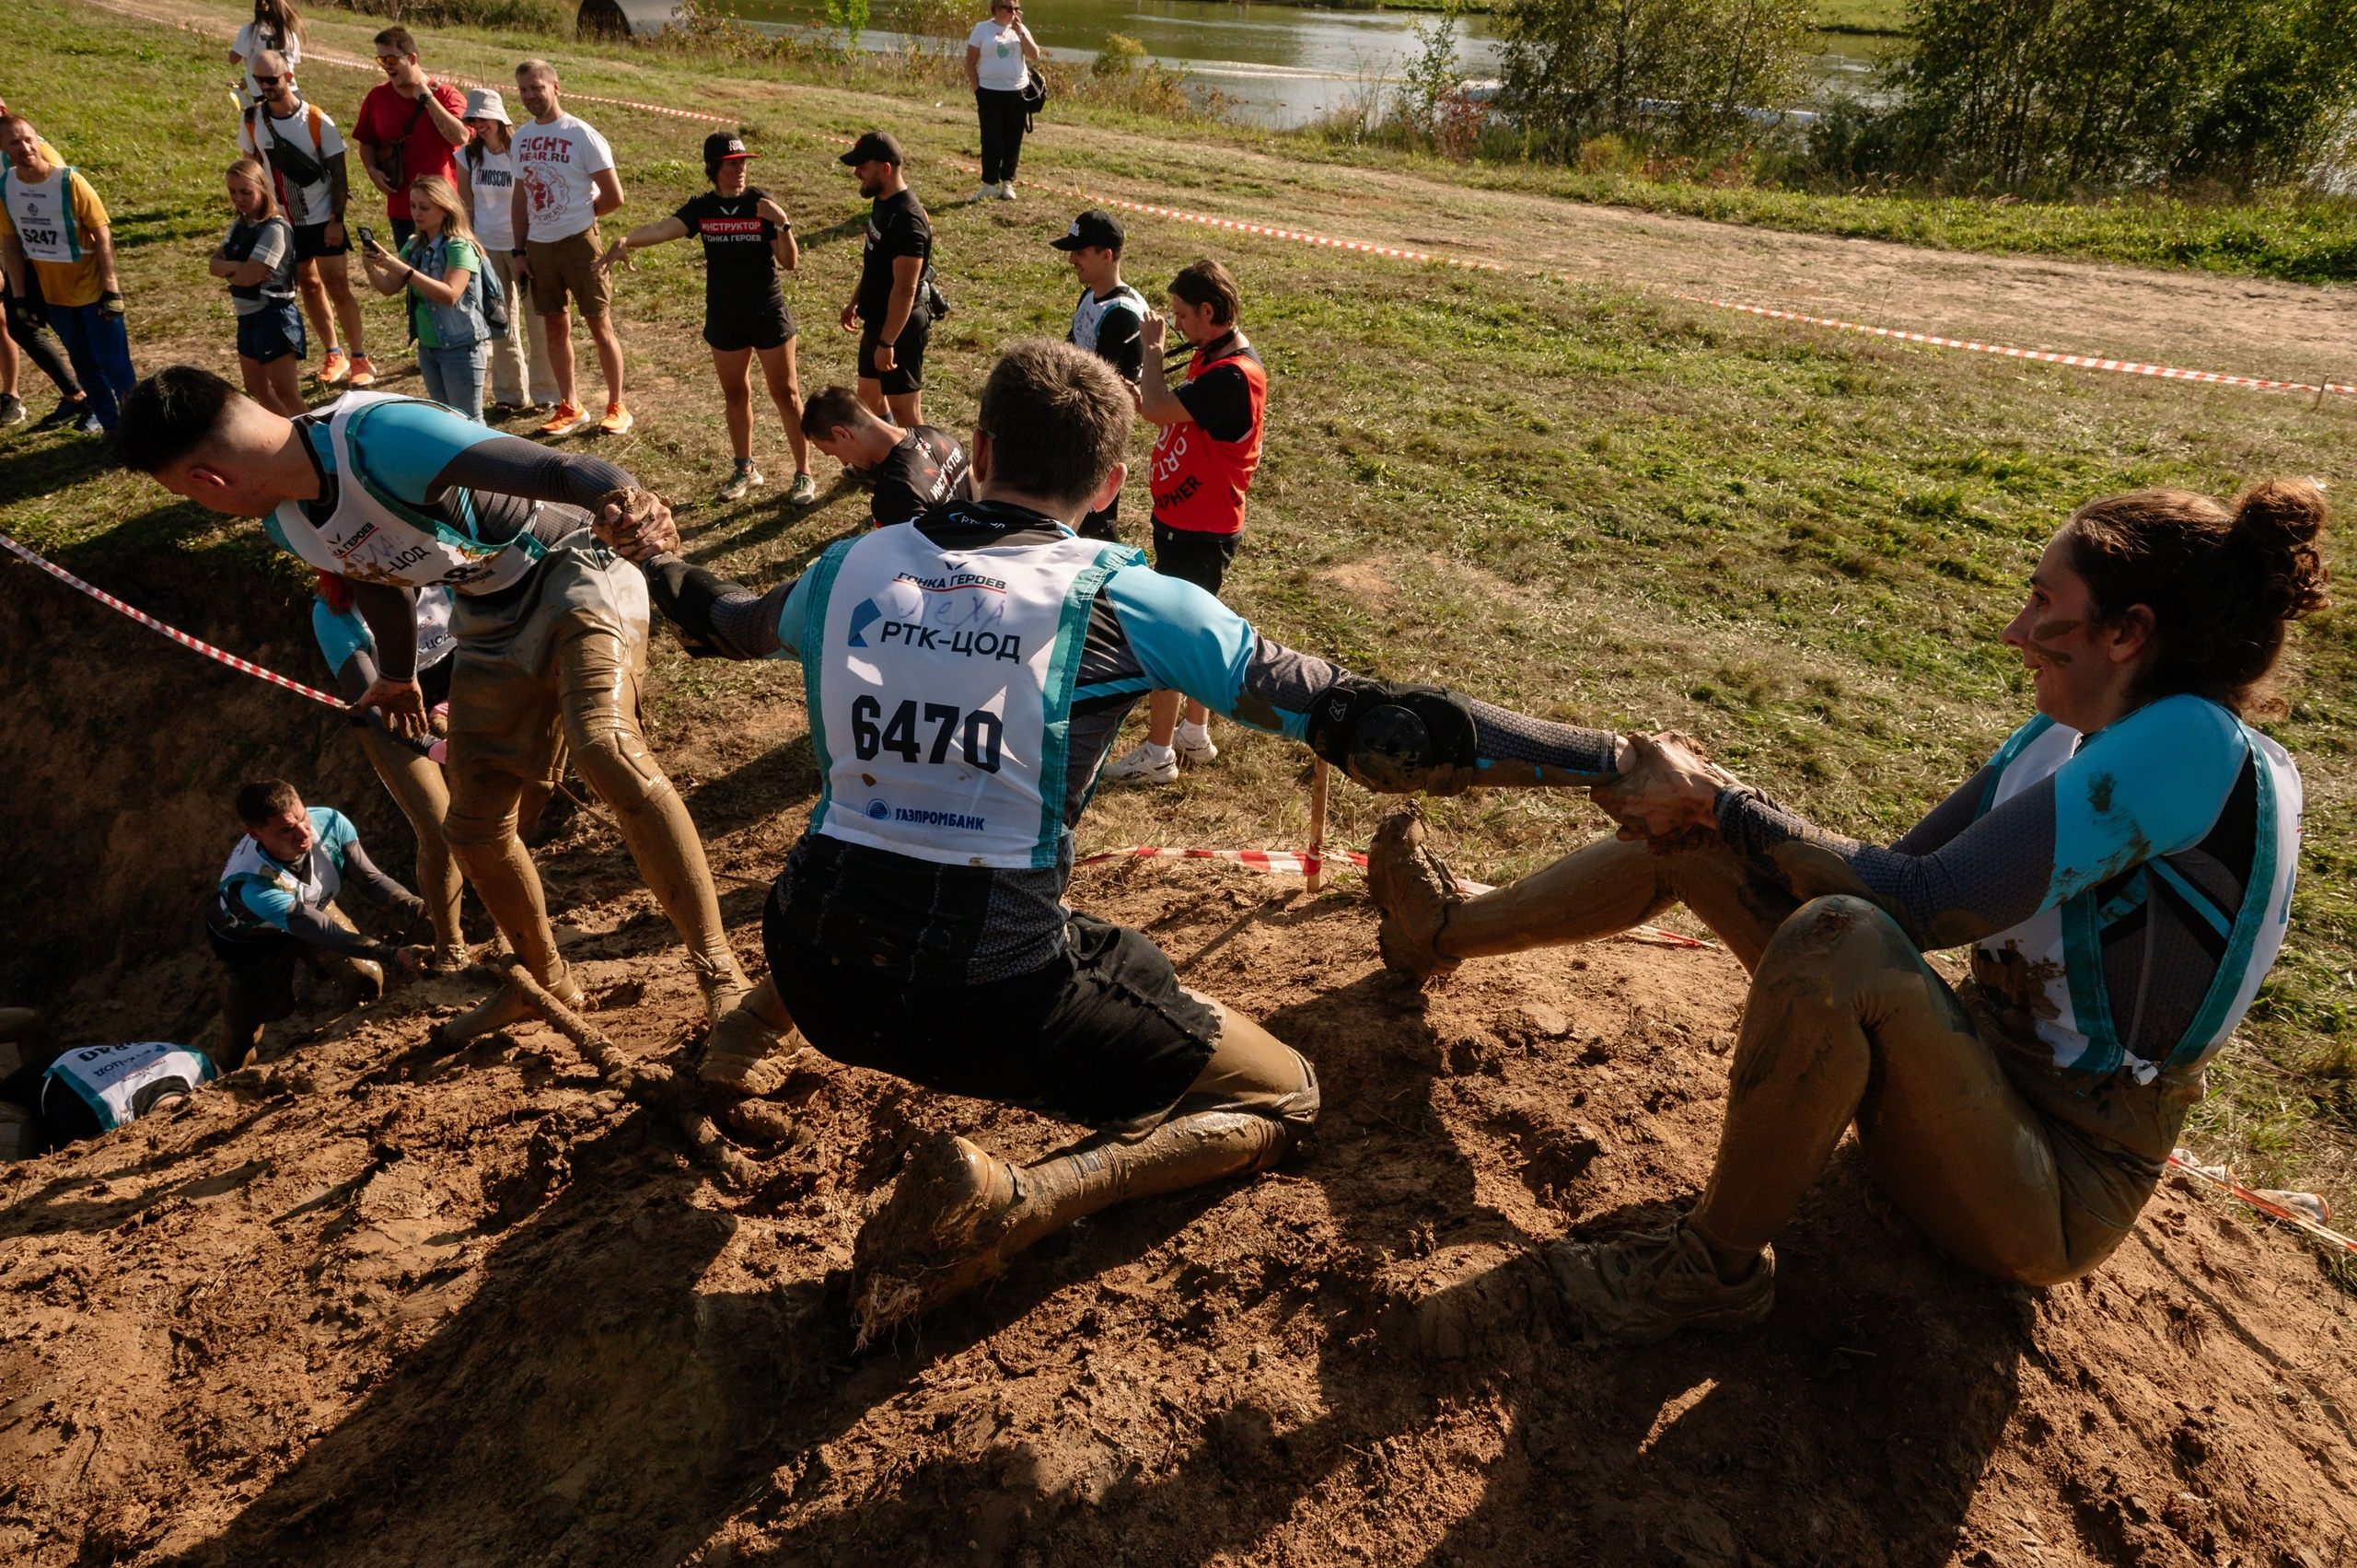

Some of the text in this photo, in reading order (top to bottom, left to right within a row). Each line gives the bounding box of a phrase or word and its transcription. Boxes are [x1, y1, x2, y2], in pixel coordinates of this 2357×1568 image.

[22, 228, 58, 246] 5247
[702, 222, 761, 232] ИНСТРУКТОР
[703, 234, 761, 243] ГОНКА ГЕРОЕВ
[343, 521, 376, 551] ГЕРОЕВ
[898, 571, 1007, 590] ГОНКА ГЕРОЕВ
[880, 621, 1021, 665] РТК-ЦОД
[852, 694, 1004, 774] 6470
[895, 807, 986, 831] ГАЗПРОМБАНК
